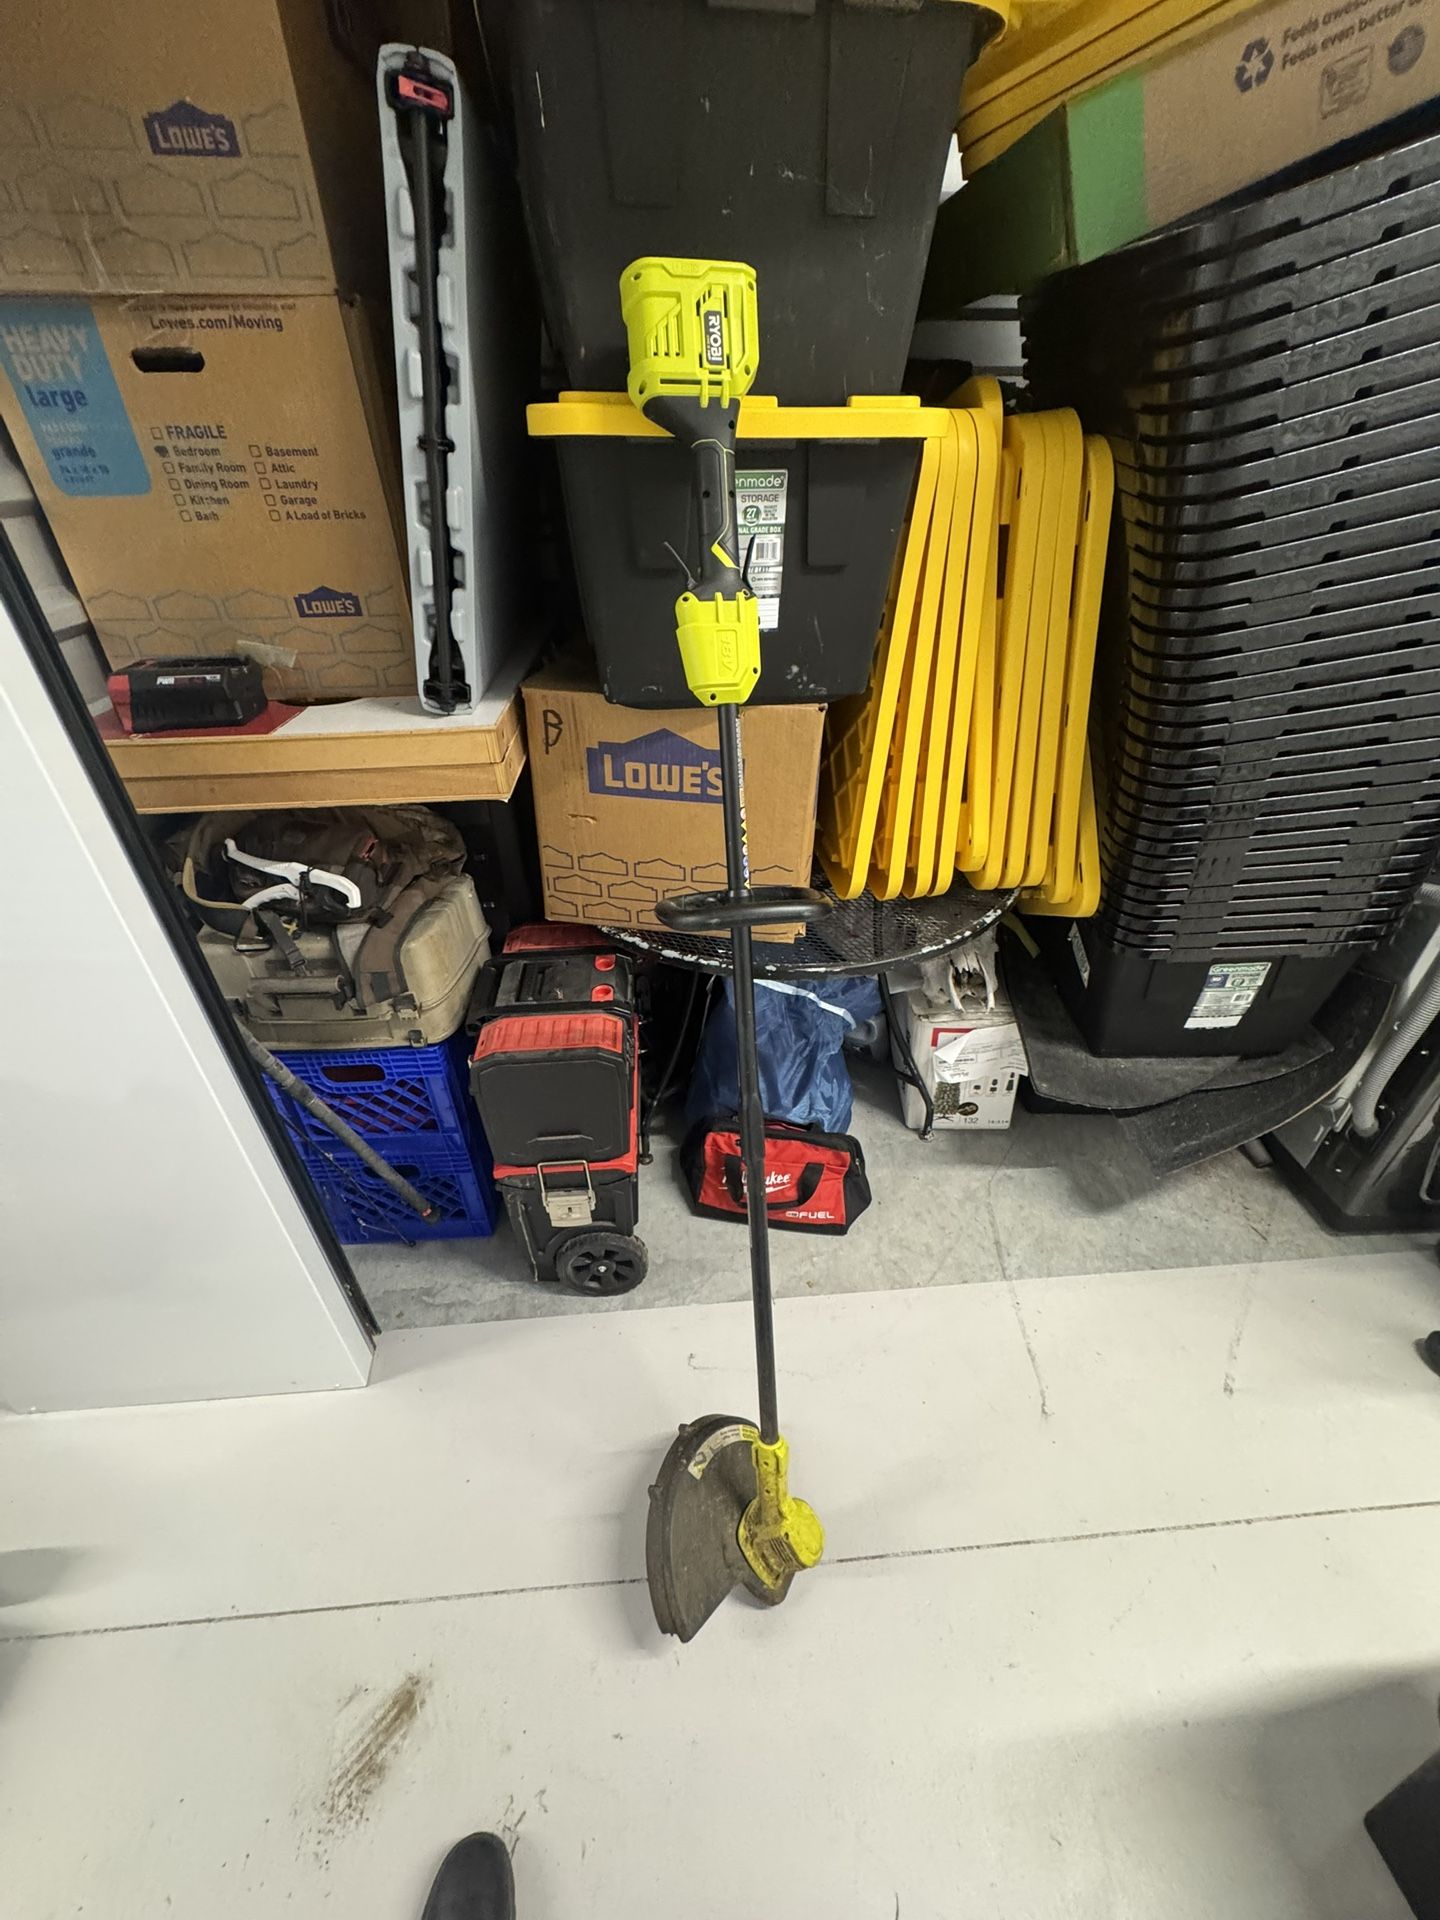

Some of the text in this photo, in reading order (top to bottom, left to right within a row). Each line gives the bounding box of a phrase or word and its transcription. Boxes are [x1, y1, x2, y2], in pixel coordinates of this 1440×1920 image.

[152, 120, 231, 151] LOWE'S
[150, 314, 284, 332] Lowes.com/Moving
[2, 323, 89, 353] HEAVY
[708, 314, 723, 362] RYOBI
[12, 353, 83, 385] DUTY
[24, 383, 89, 414] large
[166, 425, 228, 440] FRAGILE
[173, 446, 221, 458] Bedroom
[265, 446, 320, 458] Basement
[178, 462, 247, 475] Family Room
[271, 463, 296, 474] Attic
[184, 478, 250, 491] Dining Room
[275, 479, 319, 492] Laundry
[189, 495, 230, 506] Kitchen
[280, 494, 318, 507] Garage
[741, 494, 779, 503] STORAGE
[195, 511, 220, 522] Bath
[285, 510, 367, 522] A Load of Bricks
[746, 507, 757, 519] 27
[301, 598, 356, 615] LOWE'S
[603, 754, 724, 797] LOWE'S
[799, 1211, 836, 1219] FUEL
